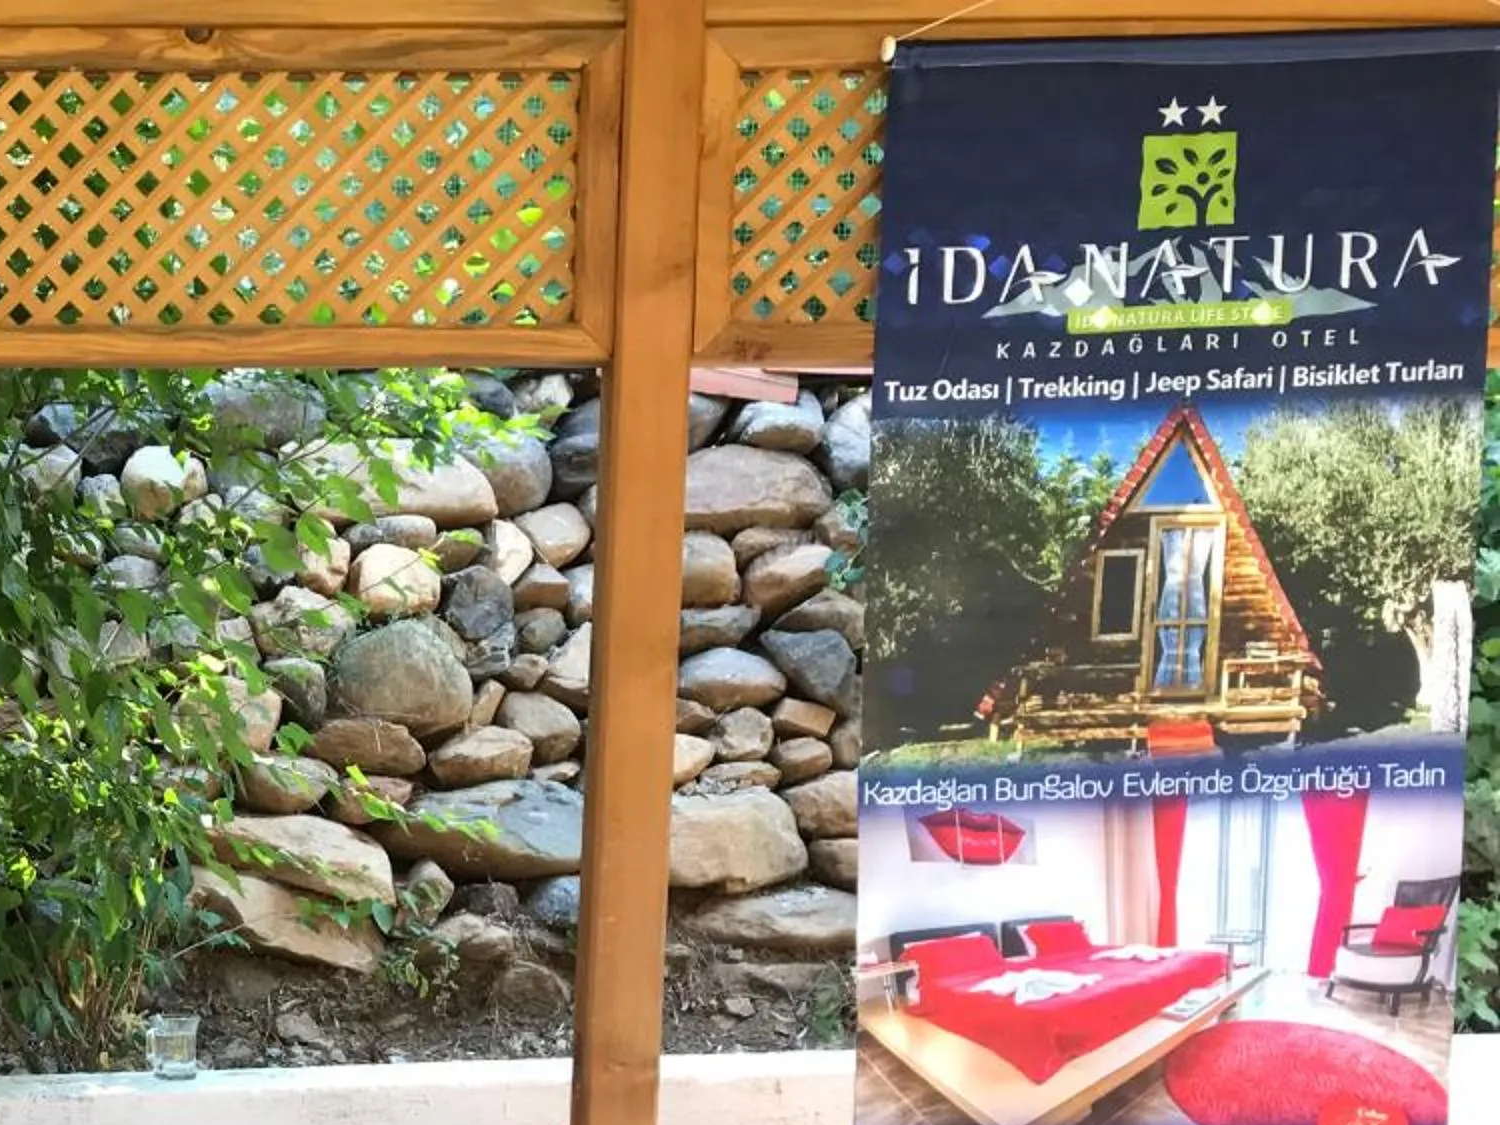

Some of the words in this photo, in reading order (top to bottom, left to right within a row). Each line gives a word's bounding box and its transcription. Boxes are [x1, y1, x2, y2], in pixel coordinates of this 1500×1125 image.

[1272, 327, 1360, 349] OTEL
[884, 379, 927, 402] Tuz
[932, 377, 998, 400] Odası
[1018, 373, 1125, 402] Trekking
[1145, 371, 1200, 396] Jeep
[1206, 366, 1273, 391] Safari
[1292, 363, 1380, 388] Bisiklet
[995, 774, 1114, 801] Bungalov
[1241, 763, 1371, 801] Özgürlüğü
[1378, 761, 1445, 788] Tadın
